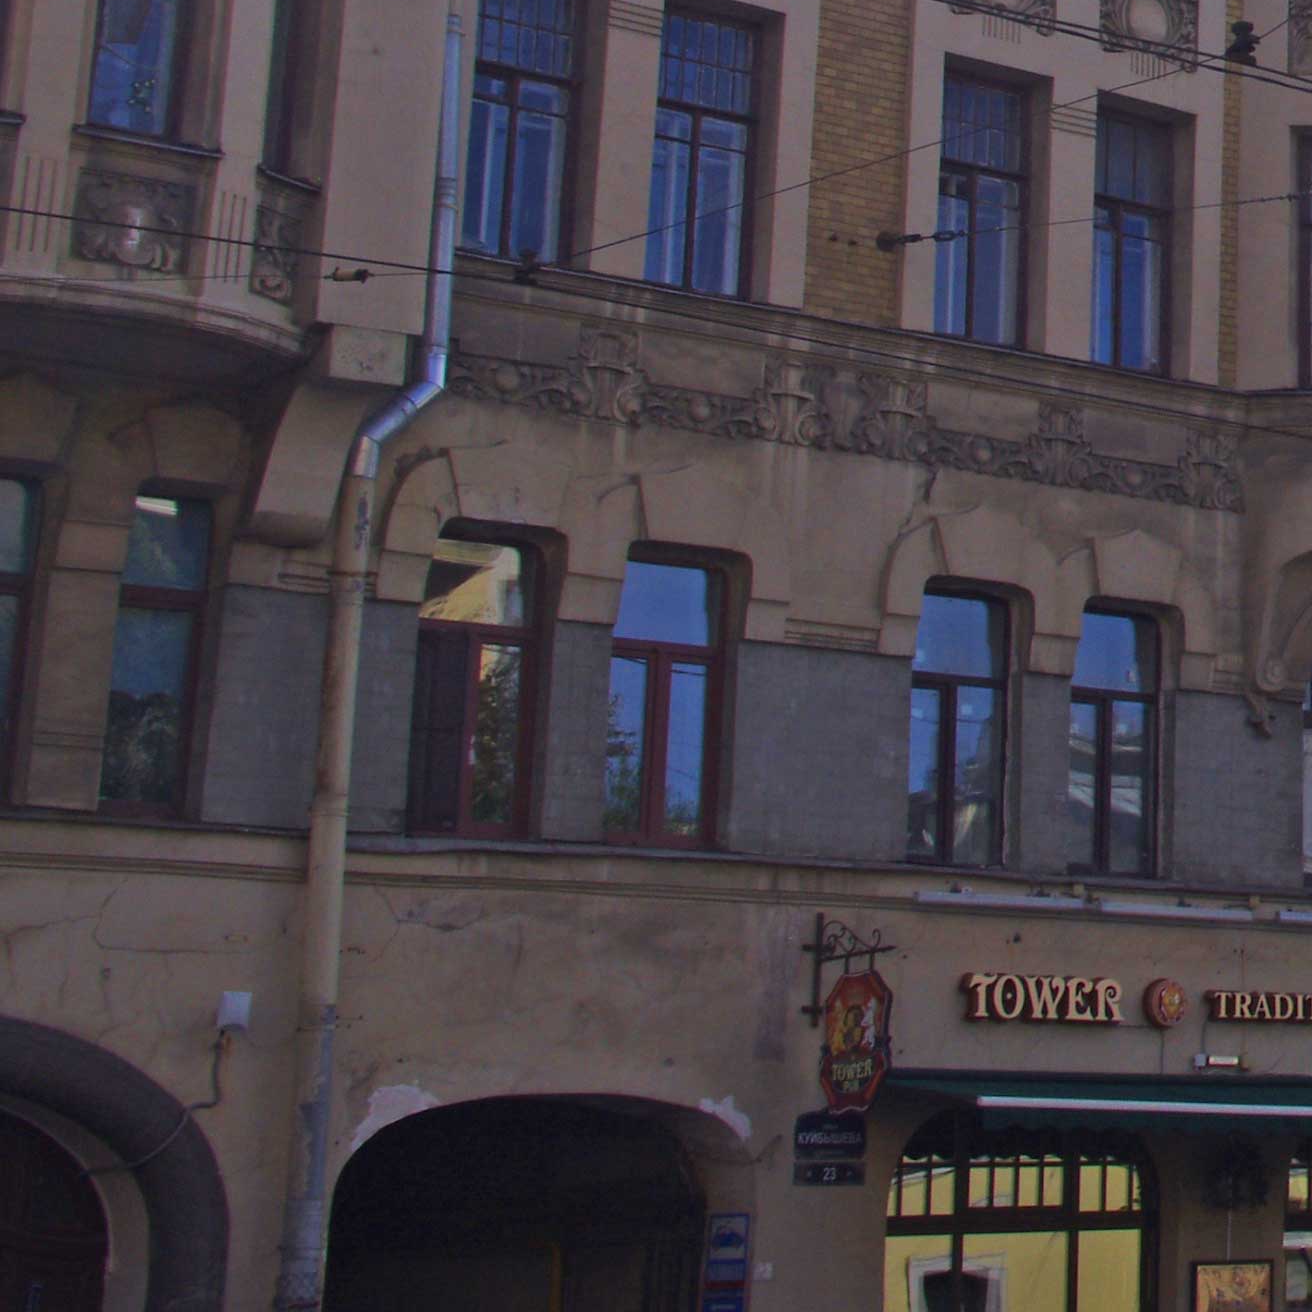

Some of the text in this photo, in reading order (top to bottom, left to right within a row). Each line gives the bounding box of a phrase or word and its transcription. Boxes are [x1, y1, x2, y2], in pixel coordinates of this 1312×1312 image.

[969, 973, 1124, 1022] TOWER
[831, 1056, 873, 1081] TOWER
[797, 1130, 863, 1145] КУЙБЫШЕВА
[822, 1167, 837, 1181] 23
